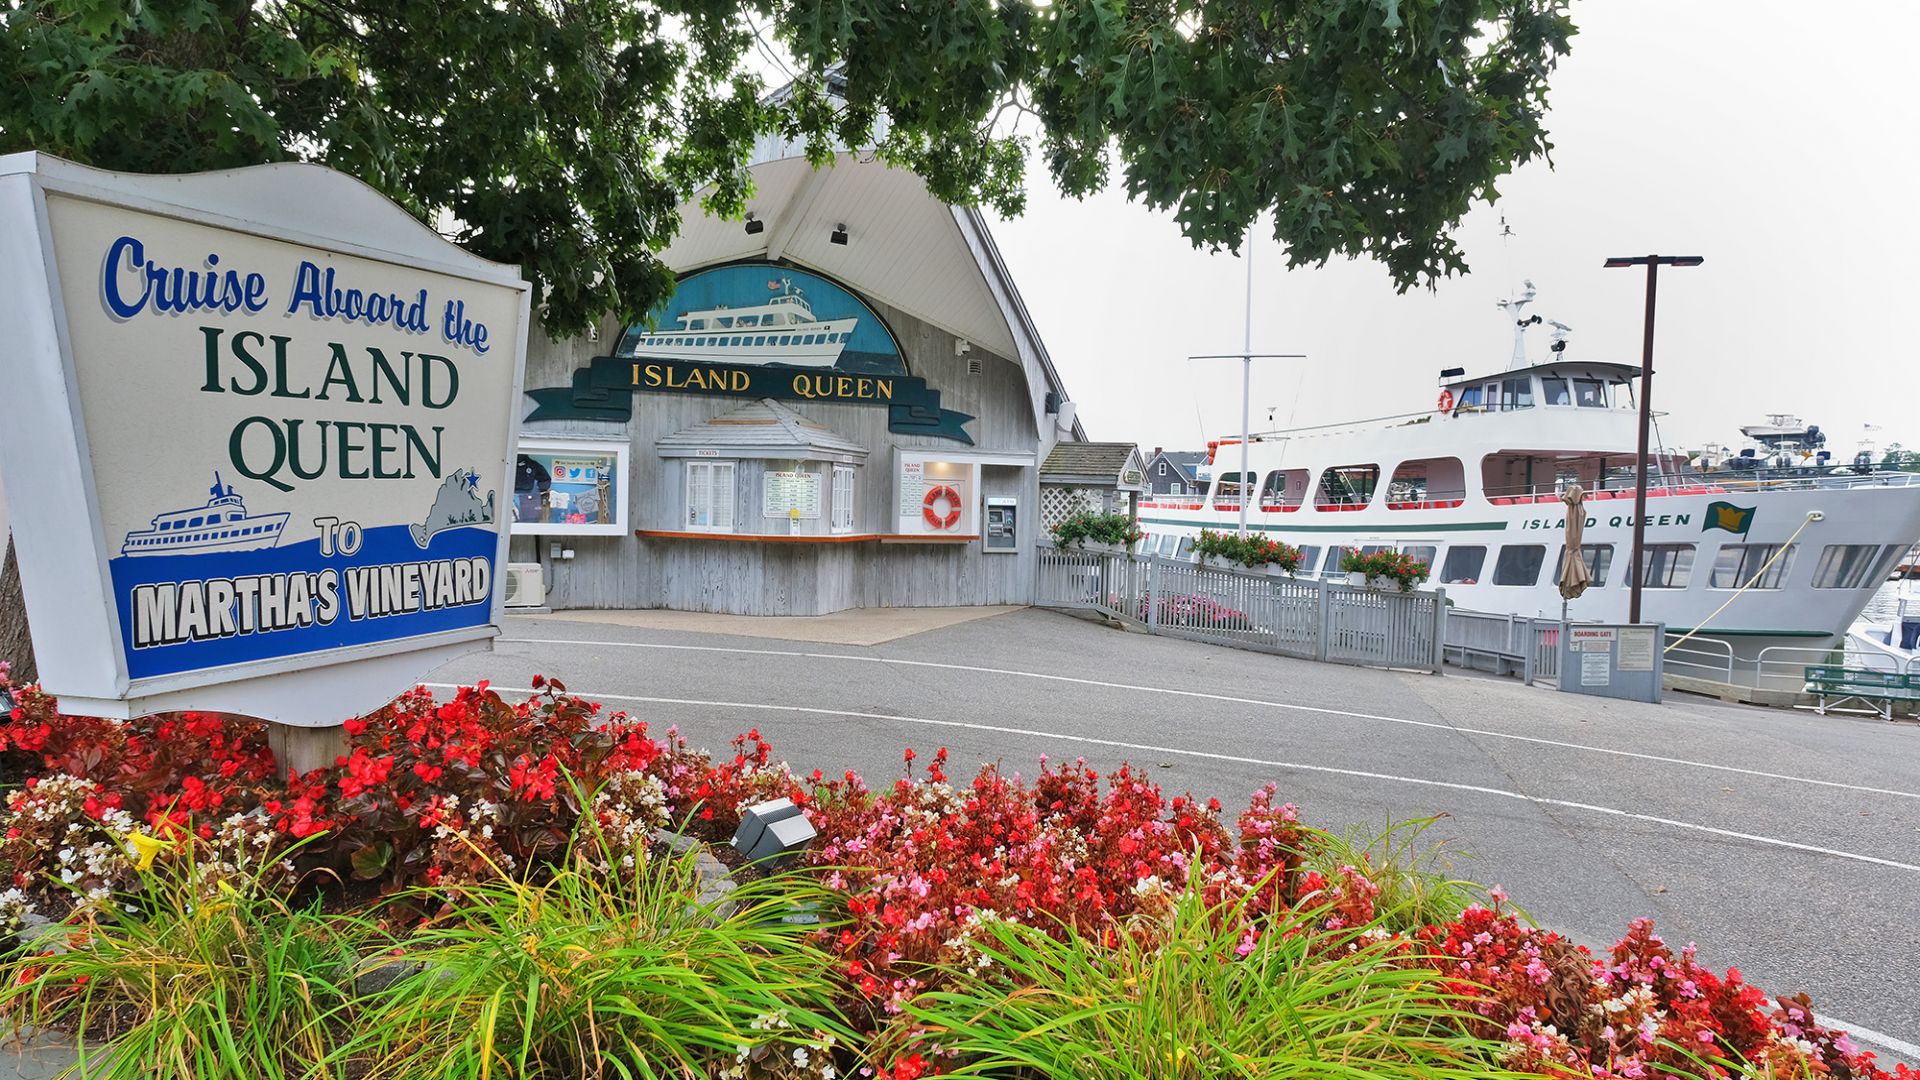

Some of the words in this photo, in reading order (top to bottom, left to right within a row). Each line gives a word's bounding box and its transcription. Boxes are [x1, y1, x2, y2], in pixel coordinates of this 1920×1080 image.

[104, 236, 268, 319] Cruise
[288, 261, 430, 332] Aboard
[443, 299, 490, 353] the
[199, 326, 460, 410] ISLAND
[631, 362, 751, 392] ISLAND
[791, 373, 894, 400] QUEEN
[228, 415, 445, 492] QUEEN
[314, 516, 364, 557] TO
[1522, 517, 1597, 529] ISLAD
[1609, 514, 1691, 528] QUEEN
[132, 568, 339, 649] MARTHA'S
[345, 556, 490, 622] VINEYARD
